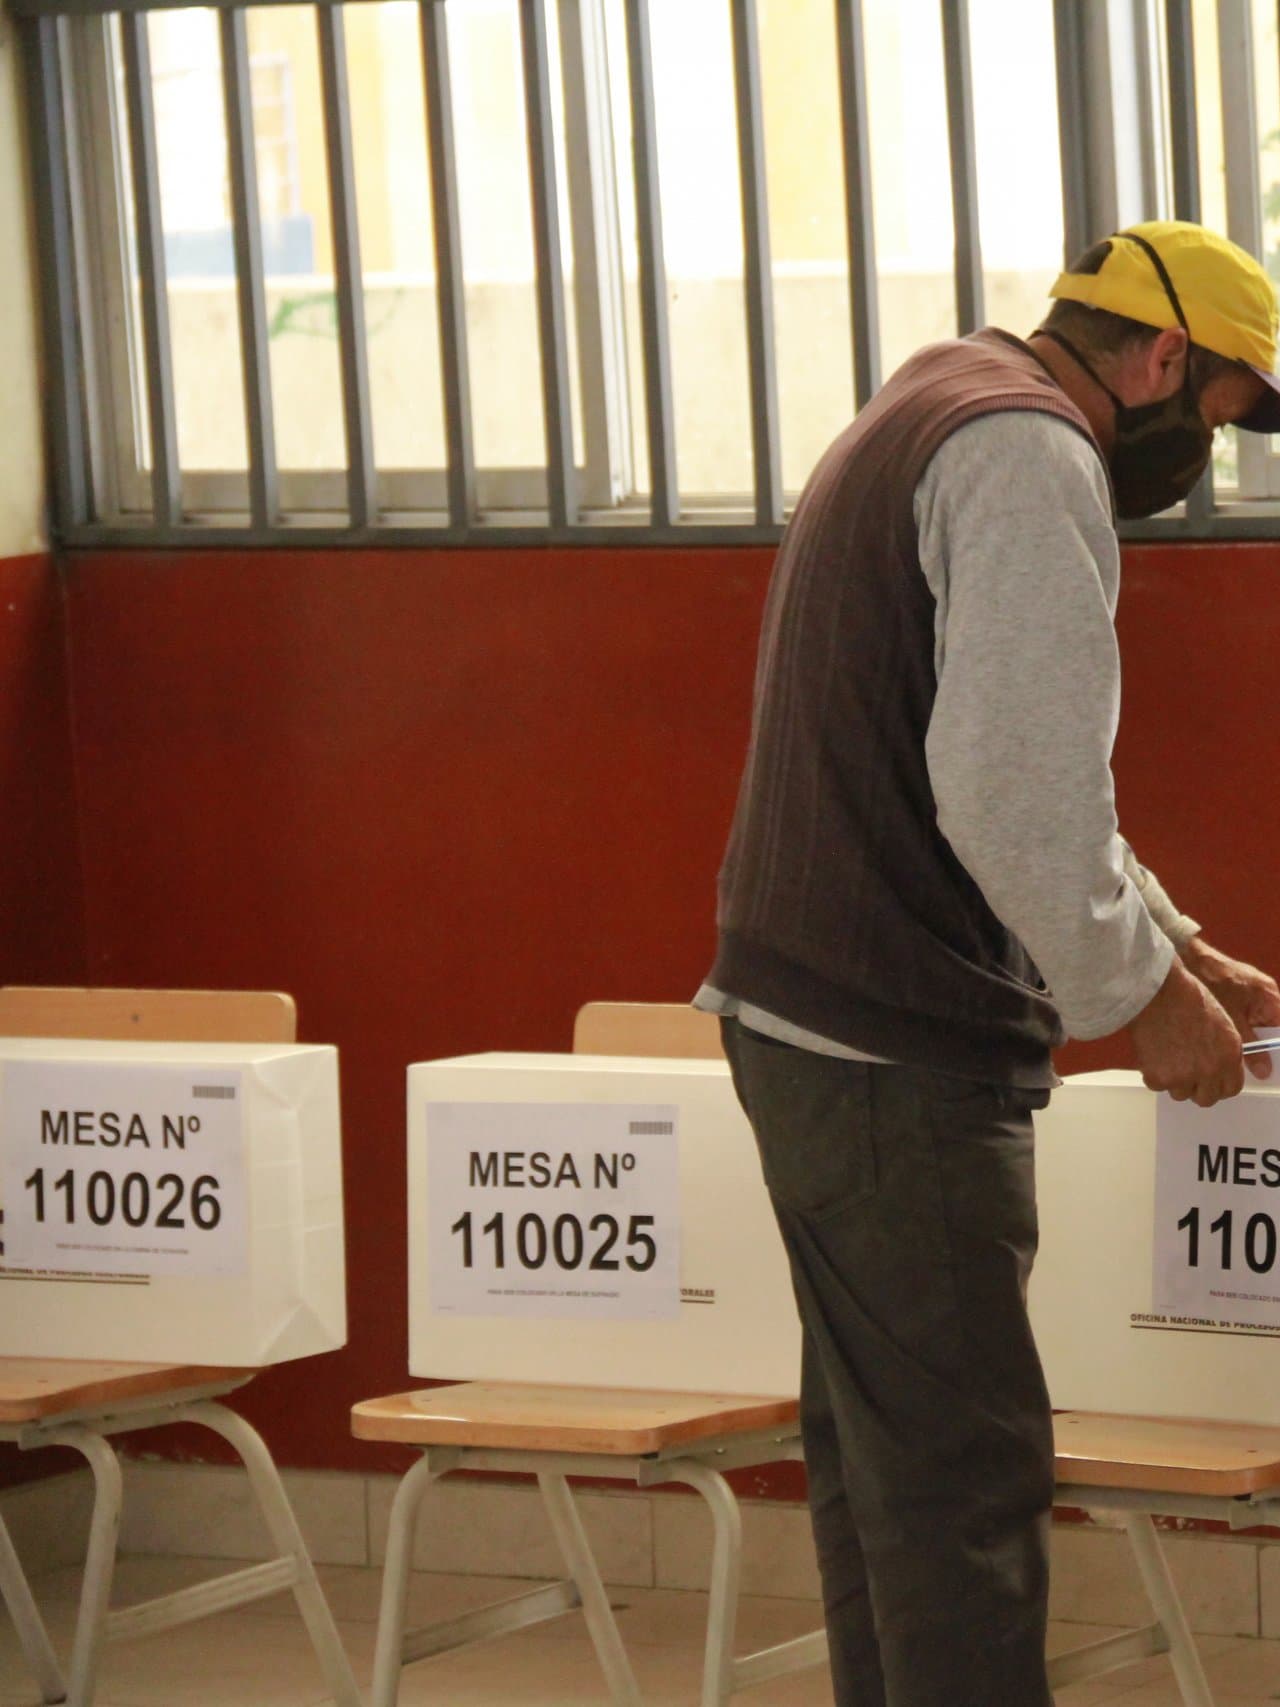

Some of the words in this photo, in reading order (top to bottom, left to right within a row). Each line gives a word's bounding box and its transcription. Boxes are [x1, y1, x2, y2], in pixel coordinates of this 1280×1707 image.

[41, 1109, 151, 1149] MESA
[469, 1151, 581, 1189] MESA
[24, 1167, 221, 1231] 110026
[451, 1211, 657, 1273] 110025
[1130, 1313, 1168, 1323] OFICINA
[1170, 1316, 1217, 1327] NACIONAL
